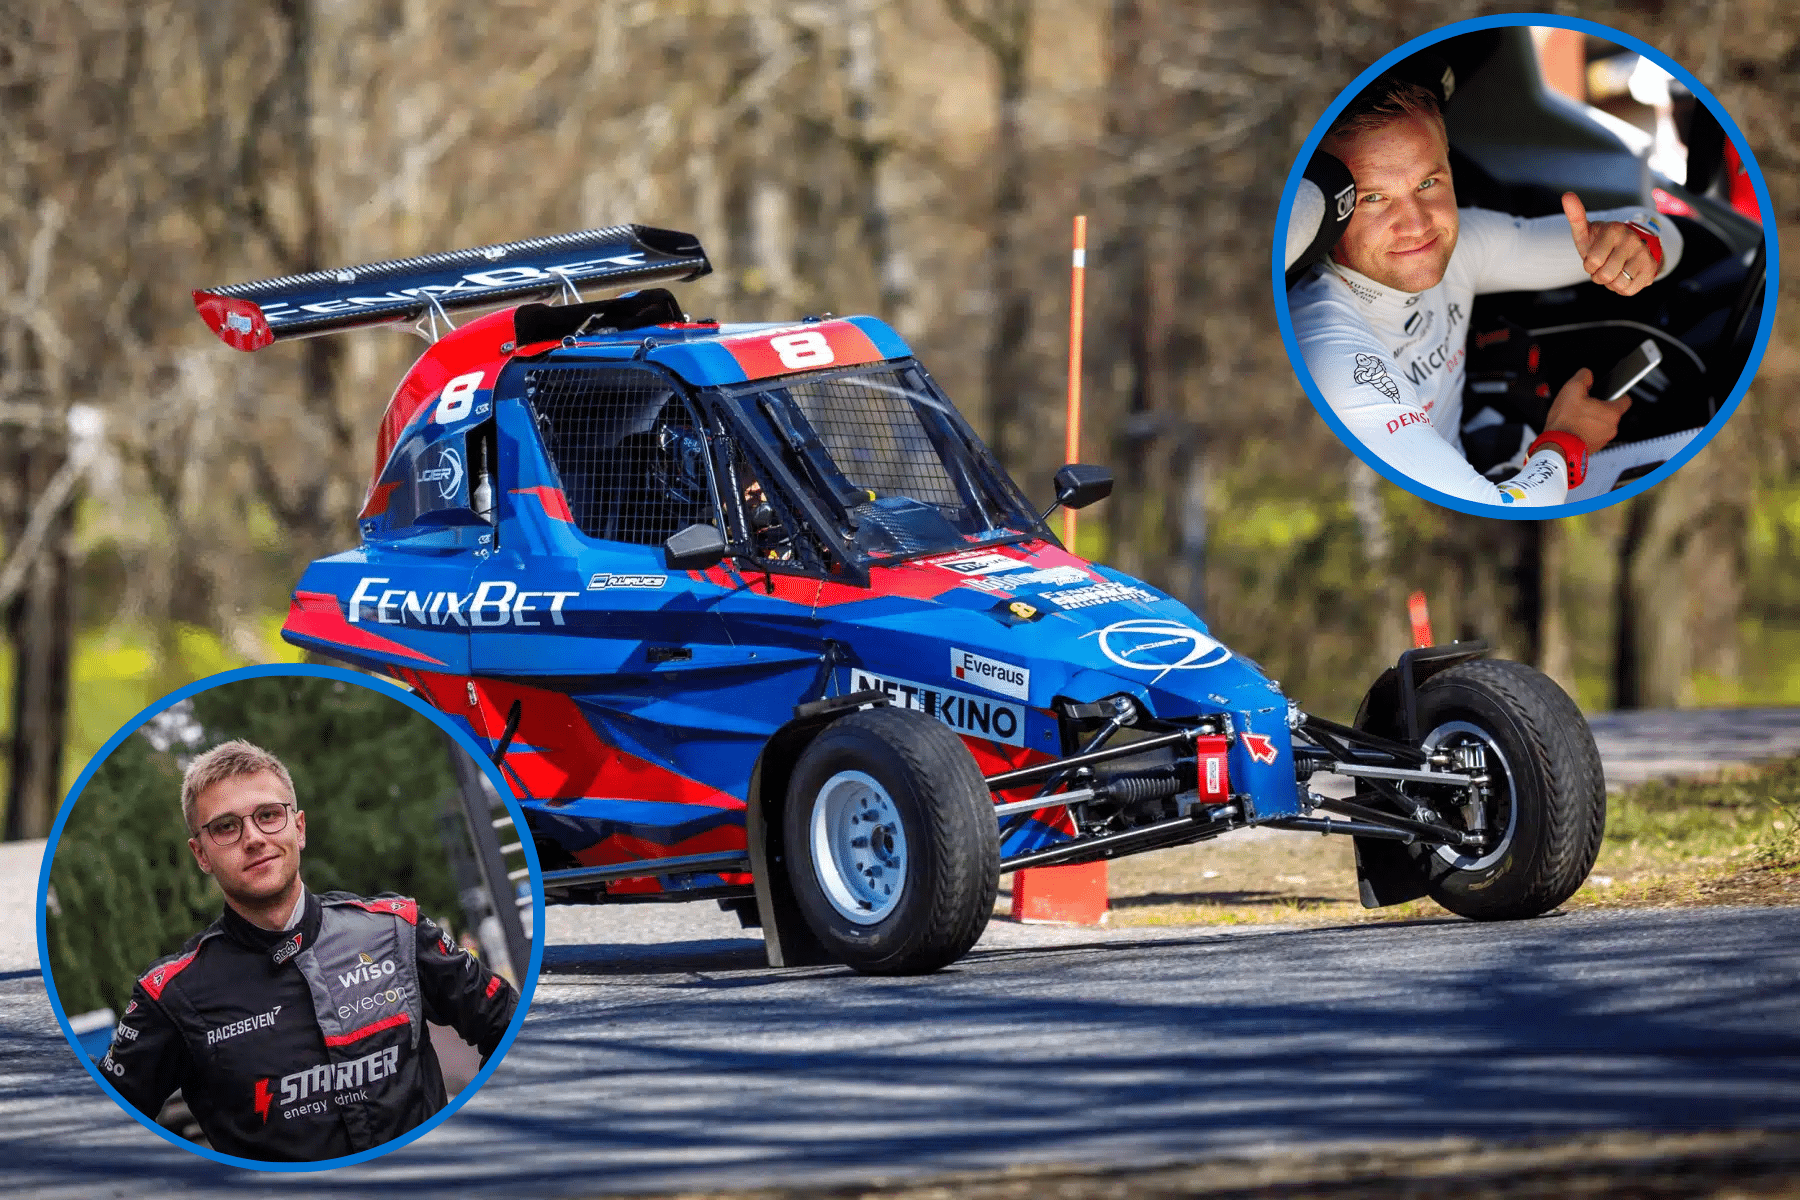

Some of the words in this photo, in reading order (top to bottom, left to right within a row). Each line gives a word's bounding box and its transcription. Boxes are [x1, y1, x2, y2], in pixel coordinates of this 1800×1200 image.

[770, 331, 834, 369] 8
[435, 370, 486, 425] 8
[1386, 411, 1434, 434] DENS
[1009, 602, 1037, 619] 8
[963, 653, 1025, 687] Everaus
[940, 694, 1018, 739] KINO
[337, 986, 408, 1019] evecon
[280, 1045, 399, 1106] STARTER
[283, 1100, 328, 1120] energy
[335, 1089, 369, 1106] drink
